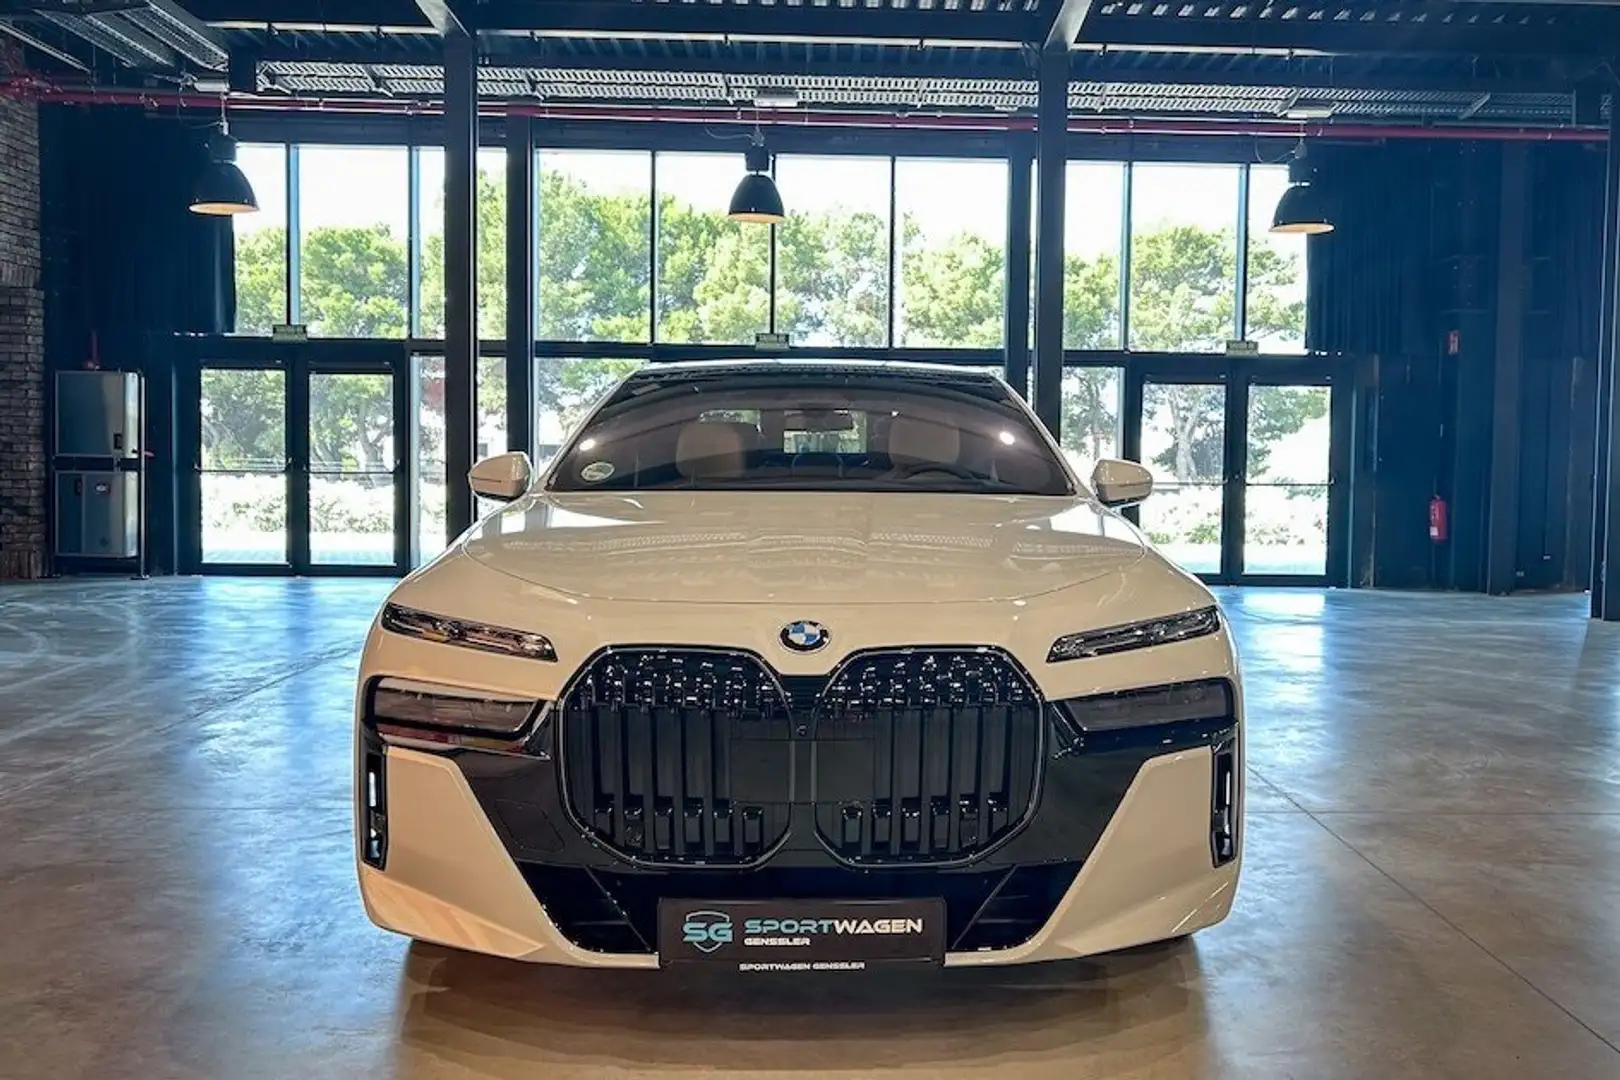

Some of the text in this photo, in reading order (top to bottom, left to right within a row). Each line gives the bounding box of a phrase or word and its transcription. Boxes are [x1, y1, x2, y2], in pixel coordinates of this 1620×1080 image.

[683, 922, 733, 942] SG
[744, 919, 923, 934] SPORTWAGEN
[744, 938, 811, 946] GENSSLER
[739, 962, 866, 971] SPORTWAGEN GENSSLER
